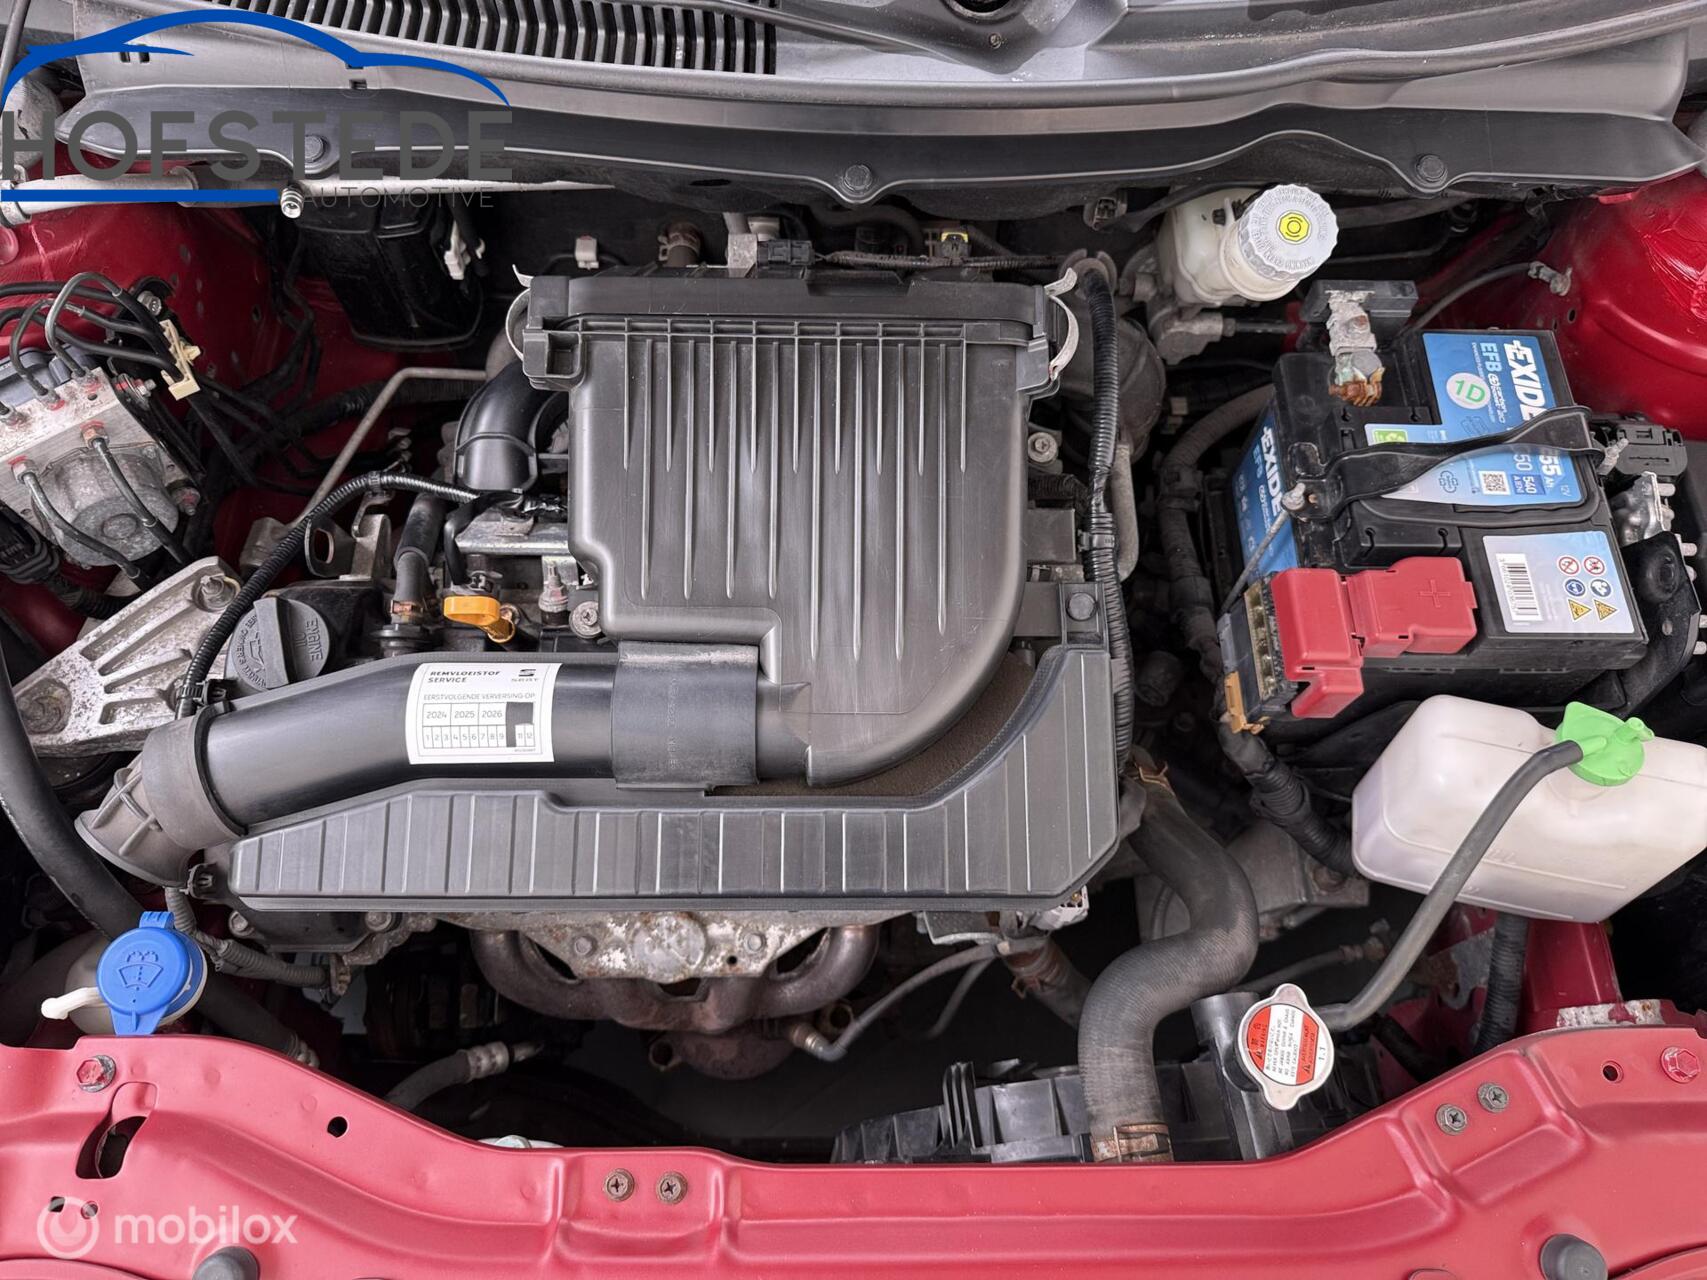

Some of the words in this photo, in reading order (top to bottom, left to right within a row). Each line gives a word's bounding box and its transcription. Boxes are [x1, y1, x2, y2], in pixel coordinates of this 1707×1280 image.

[1480, 342, 1503, 374] EFB
[1453, 379, 1486, 403] 1D
[1504, 340, 1547, 421] EXIDE
[1261, 426, 1283, 517] EXIDE
[1539, 455, 1562, 476] 55
[1523, 475, 1537, 494] 540
[295, 631, 307, 648] OIL
[306, 617, 323, 661] ENGINE
[426, 711, 448, 719] 2024
[454, 711, 476, 719] 2025
[481, 710, 503, 719] 2026
